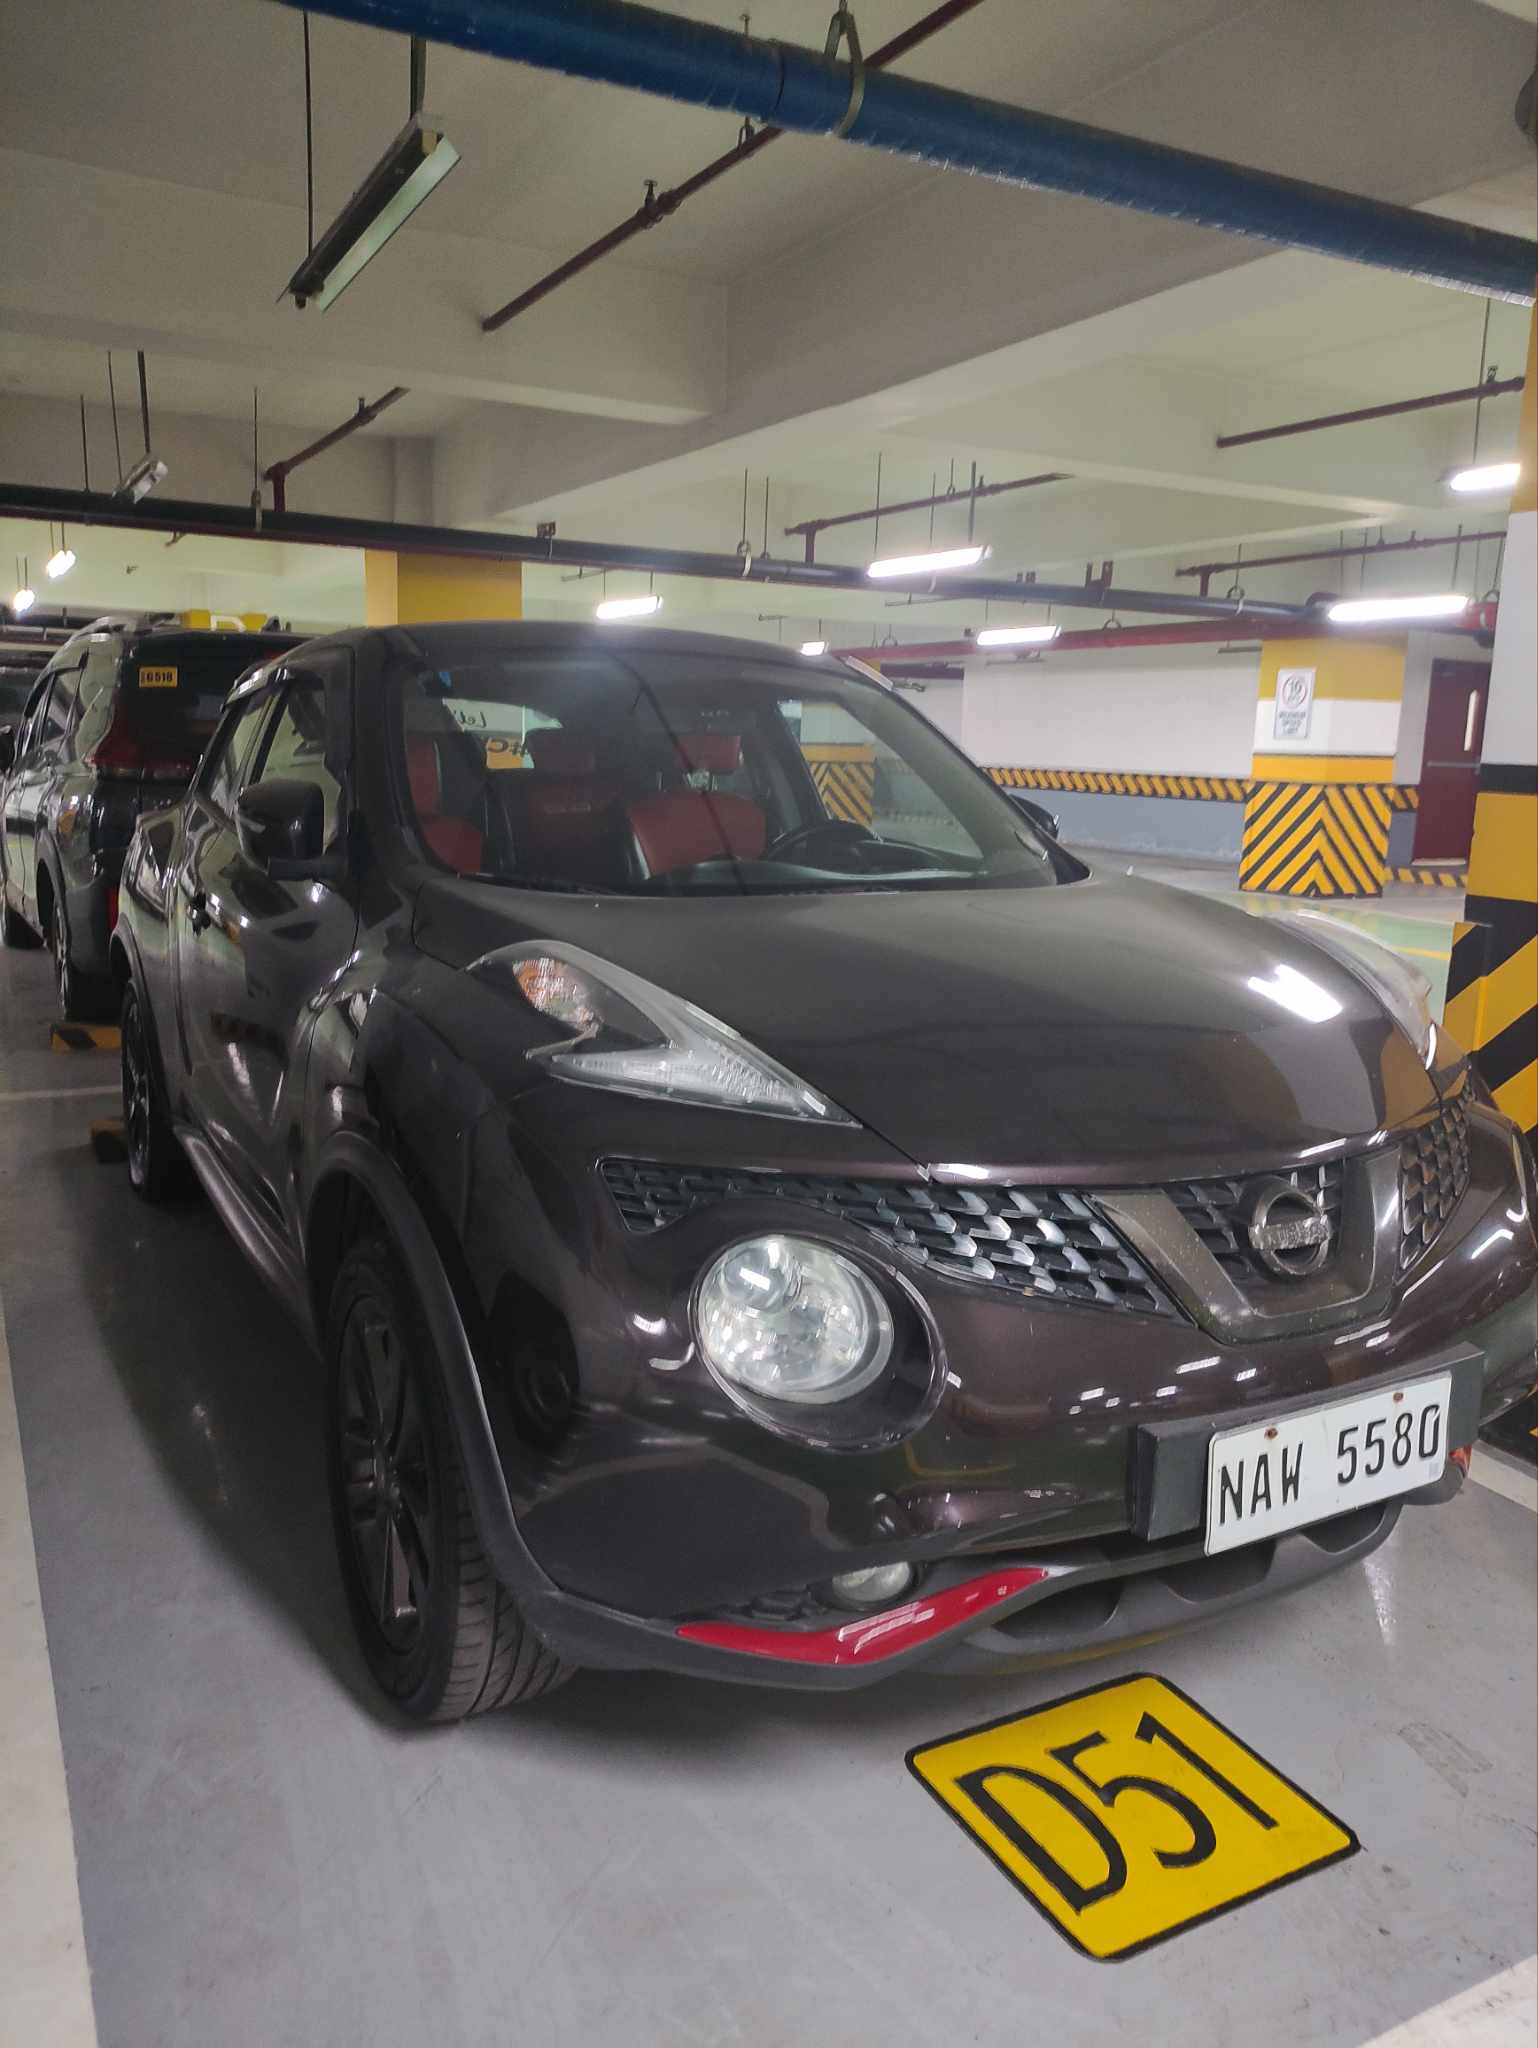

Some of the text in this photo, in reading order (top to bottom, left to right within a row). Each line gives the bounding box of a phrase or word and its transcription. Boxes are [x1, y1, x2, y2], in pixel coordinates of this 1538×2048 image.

[1220, 1404, 1440, 1525] NAW 5580
[955, 1711, 1278, 1915] D51
